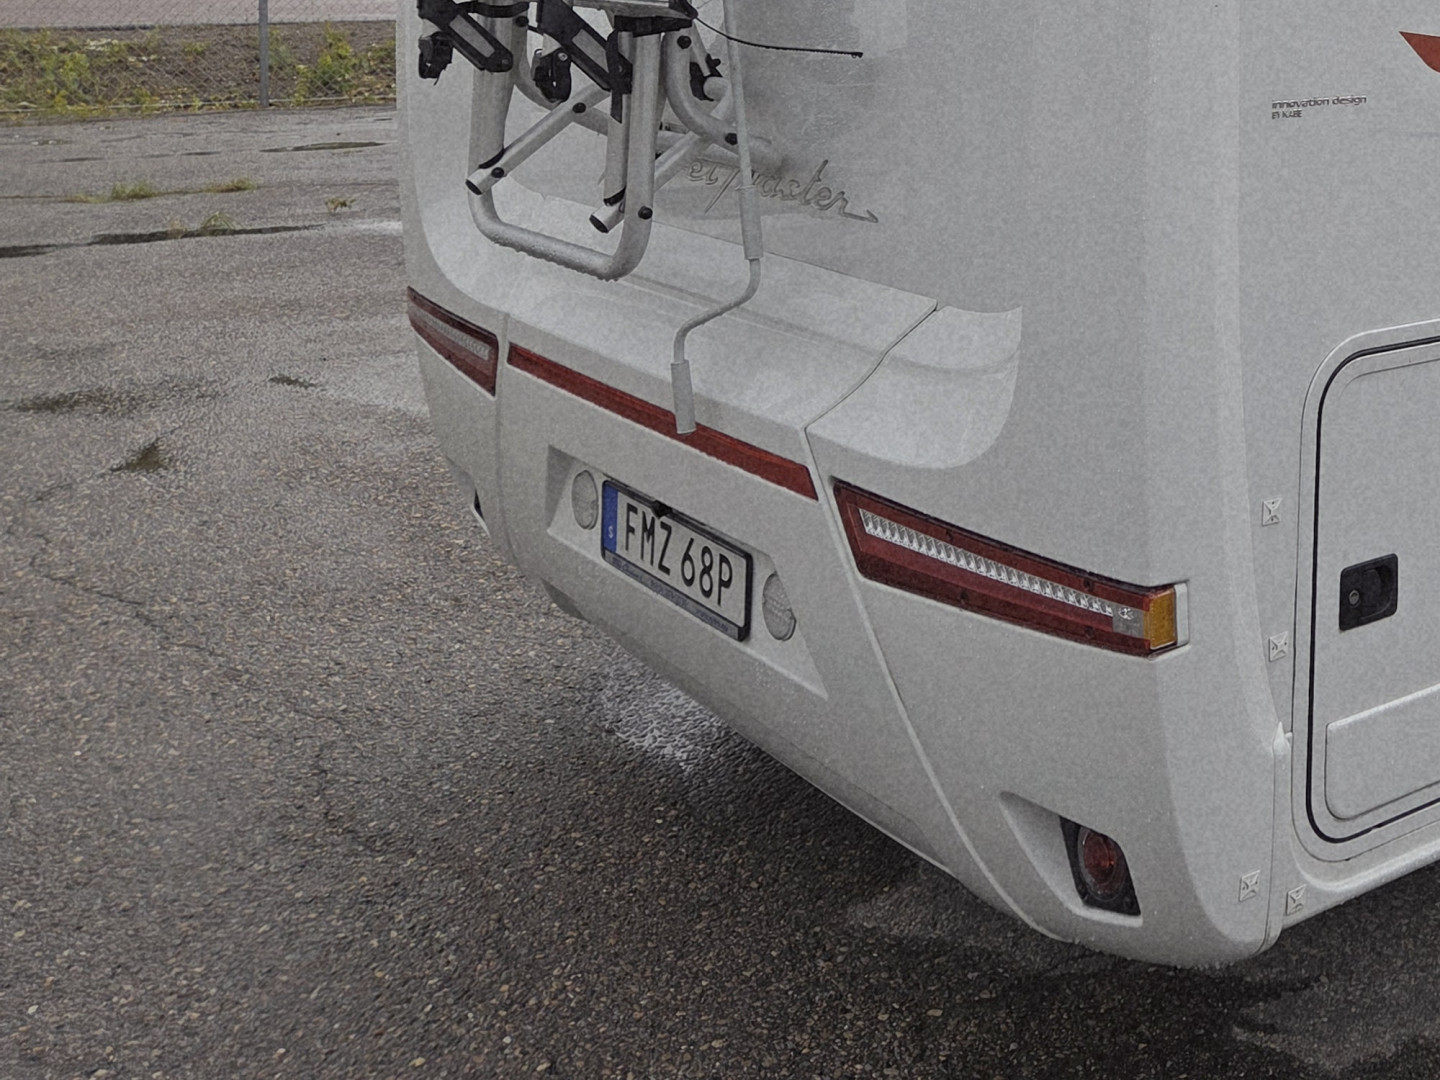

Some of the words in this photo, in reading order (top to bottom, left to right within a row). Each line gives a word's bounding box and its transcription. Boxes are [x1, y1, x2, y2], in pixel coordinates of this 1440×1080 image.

[1271, 98, 1329, 109] innovation
[1332, 95, 1367, 106] design
[608, 525, 615, 539] S
[625, 502, 672, 576] FMZ
[681, 538, 733, 607] 68P
